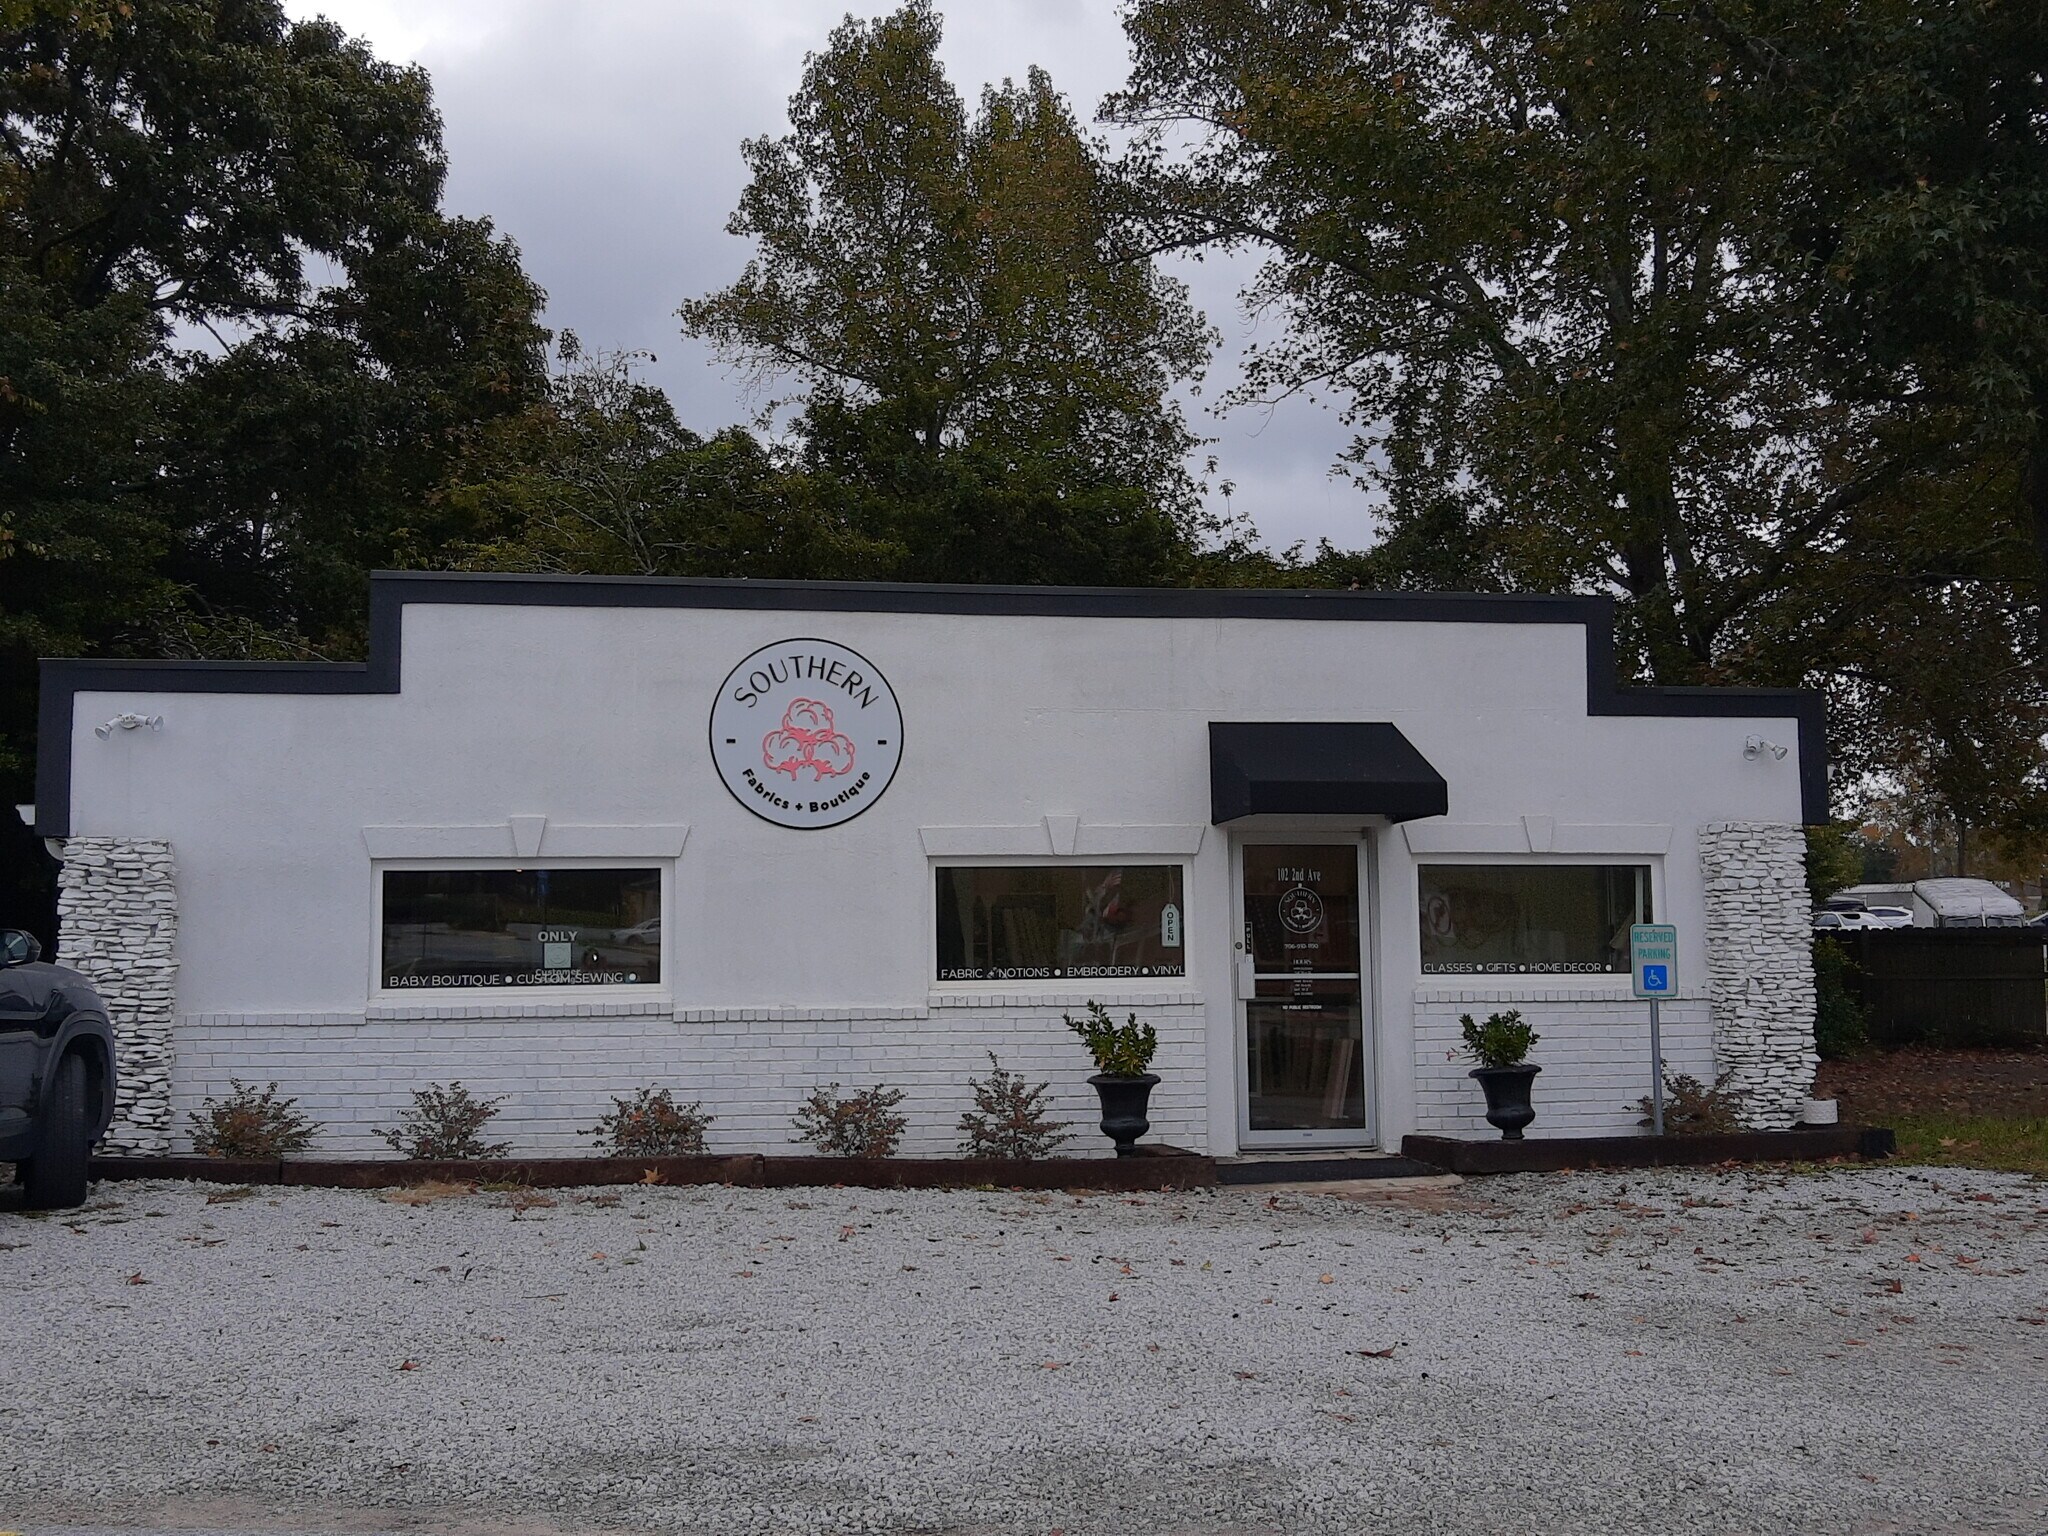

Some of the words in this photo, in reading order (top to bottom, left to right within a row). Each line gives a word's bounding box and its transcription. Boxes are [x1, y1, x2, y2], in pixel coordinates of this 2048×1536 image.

[734, 655, 880, 709] SOUTHERN
[742, 768, 790, 810] Fabrics
[809, 771, 870, 812] Boutique
[1278, 867, 1289, 881] 102
[1292, 867, 1304, 881] 2nd
[1308, 868, 1321, 881] Ave
[1166, 911, 1175, 941] OPEN
[537, 931, 578, 942] ONLY
[1634, 931, 1674, 943] RESERVED
[1638, 948, 1671, 959] PARKING
[535, 968, 581, 977] Customer
[941, 968, 983, 979] FABRIC
[998, 967, 1050, 978] NOTIONS
[1067, 966, 1139, 977] EMBROIDERY
[1152, 965, 1185, 976] VINYL
[1423, 963, 1473, 973] CLASSES
[1486, 963, 1516, 973] GIFTS
[1529, 963, 1561, 972] HOME
[1563, 962, 1602, 972] DECOR
[389, 975, 429, 987] BABY
[432, 974, 500, 987] BOUTIQUE
[516, 973, 571, 986] CUSTOM
[575, 972, 624, 984] SEWING
